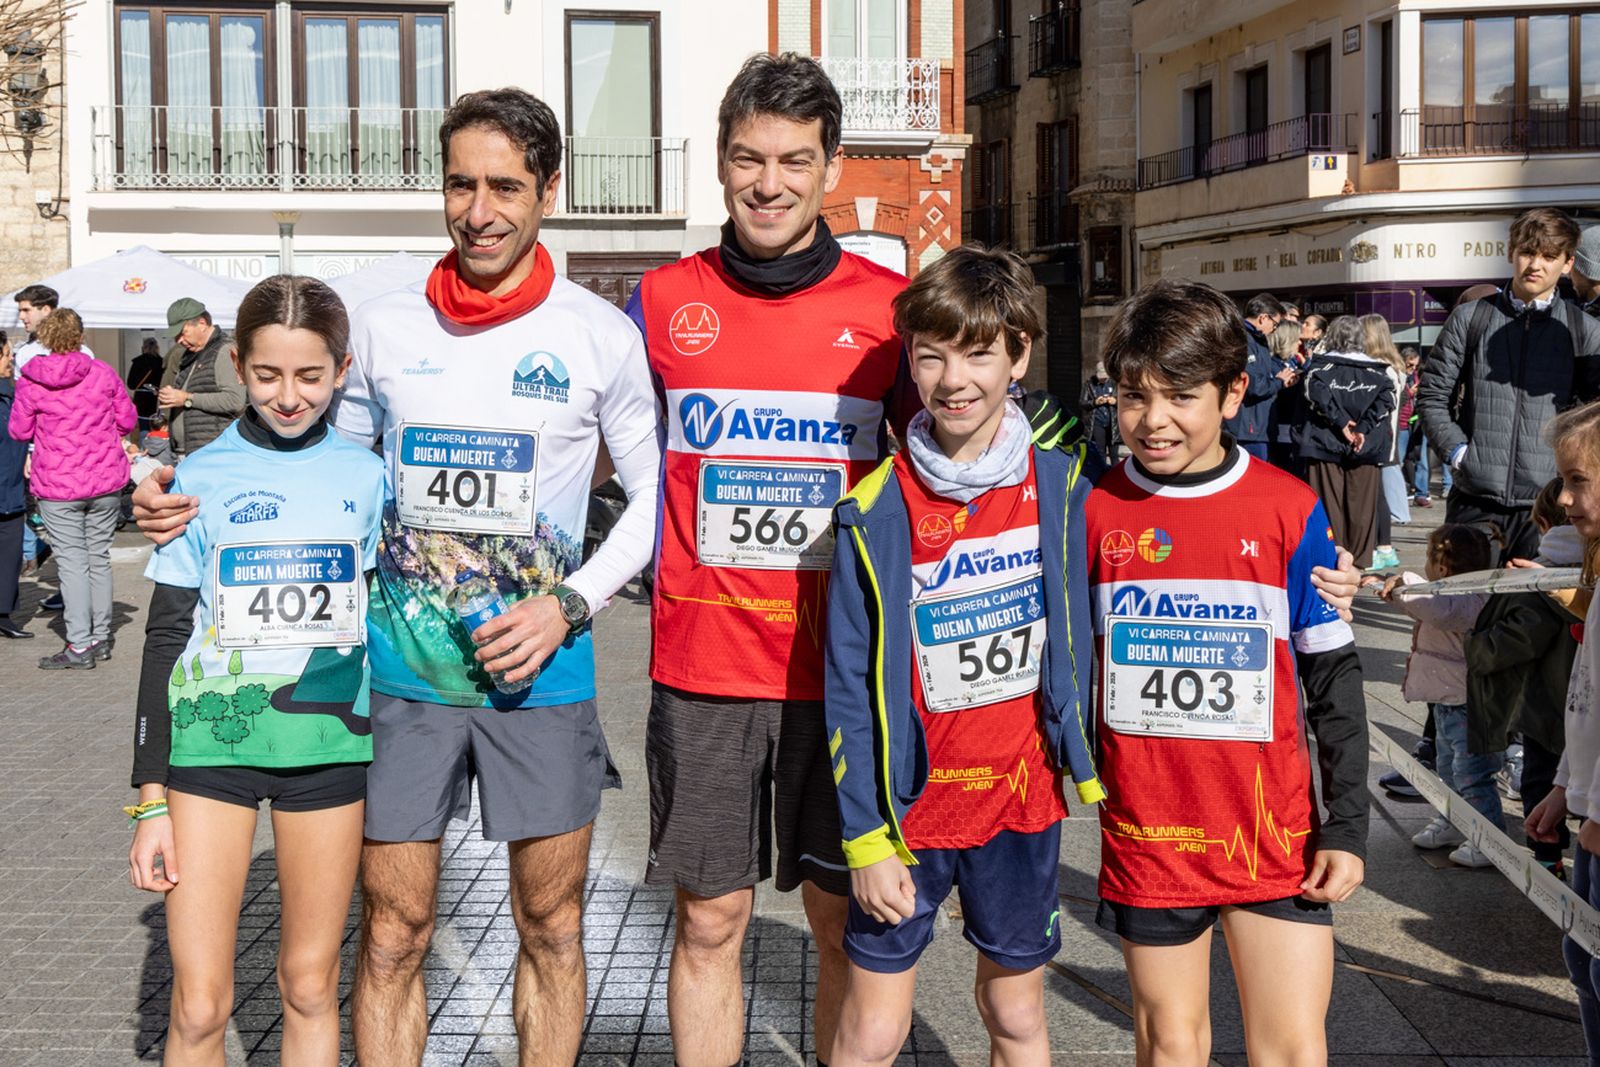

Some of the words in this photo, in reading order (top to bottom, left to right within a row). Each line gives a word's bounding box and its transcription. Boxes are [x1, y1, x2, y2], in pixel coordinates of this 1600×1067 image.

[1394, 242, 1436, 258] NTRO
[1464, 241, 1504, 257] PADR
[1280, 252, 1298, 268] REAL
[512, 382, 541, 393] ULTRA
[544, 385, 568, 397] TRAIL
[512, 390, 542, 400] BOSQUES
[556, 396, 568, 404] SUR
[754, 408, 782, 416] GRUPO
[727, 408, 858, 446] Avanza
[416, 432, 424, 441] VI
[426, 432, 466, 444] CARRERA
[470, 436, 519, 448] CAMINATA
[414, 446, 446, 463] BUENA
[450, 448, 496, 466] MUERTE
[718, 470, 727, 480] VI
[729, 470, 772, 481] CARRERA
[776, 472, 826, 483] CAMINATA
[428, 470, 496, 508] 401
[717, 484, 752, 500] BUENA
[756, 486, 802, 502] MUERTE
[224, 493, 247, 508] Escuela
[234, 504, 278, 522] ATARFE
[414, 505, 443, 513] FRANCISCO
[730, 508, 808, 546] 566
[234, 552, 244, 560] VI
[247, 550, 292, 560] CARRERA
[295, 548, 342, 558] CAMINATA
[973, 548, 994, 559] GRUPO
[953, 547, 1042, 579] Avanza
[234, 566, 272, 582] BUENA
[276, 563, 322, 580] MUERTE
[248, 584, 332, 623] 402
[718, 593, 792, 608] TRAILRUNNERS
[930, 608, 940, 618] VI
[942, 598, 990, 616] CARRERA
[992, 584, 1038, 605] CAMINATA
[1154, 594, 1256, 620] Avanza
[932, 620, 974, 640] BUENA
[976, 606, 1024, 632] MUERTE
[1128, 628, 1139, 638] VI
[1141, 628, 1190, 640] CARRERA
[1194, 630, 1250, 643] CAMINATA
[958, 626, 1032, 682] 567
[1128, 644, 1168, 662] BUENA
[1172, 646, 1224, 664] MUERTE
[970, 680, 990, 688] DIEGO
[1140, 669, 1235, 713] 403
[1142, 710, 1179, 718] FRANCISCO
[1181, 712, 1210, 720] CUENCA
[929, 766, 992, 778] RUNNERS
[1117, 822, 1205, 838] TRAILRUNNERS
